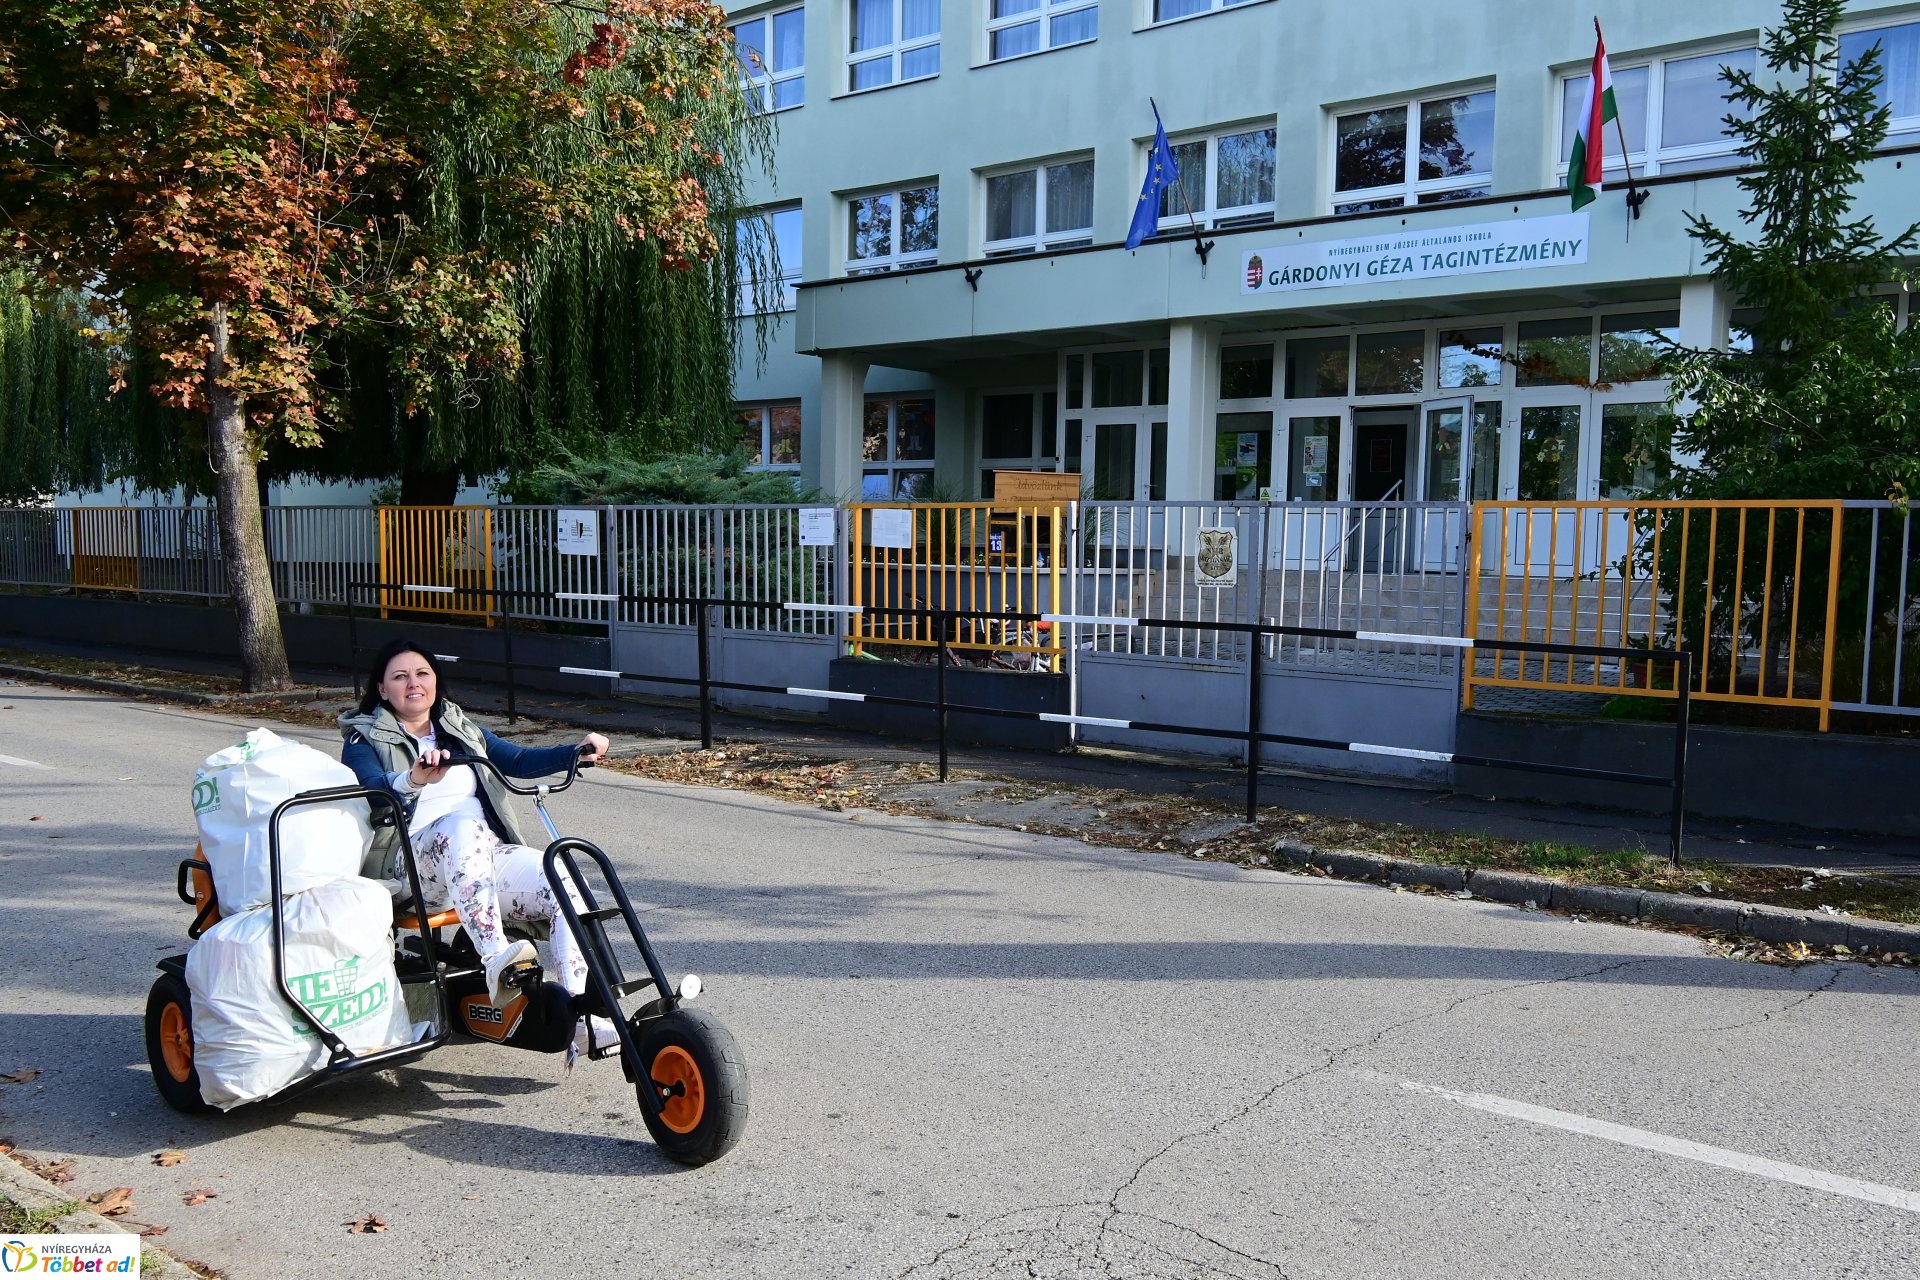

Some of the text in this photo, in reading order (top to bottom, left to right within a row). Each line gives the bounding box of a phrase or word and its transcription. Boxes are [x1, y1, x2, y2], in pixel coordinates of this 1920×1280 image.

[1375, 243, 1390, 252] BEM
[1465, 231, 1492, 242] ISKOLA
[1268, 238, 1582, 286] GÁRDONYI GÉZA TAGINTÉZMÉNY
[287, 970, 339, 1005] TE
[468, 1004, 503, 1024] BERG
